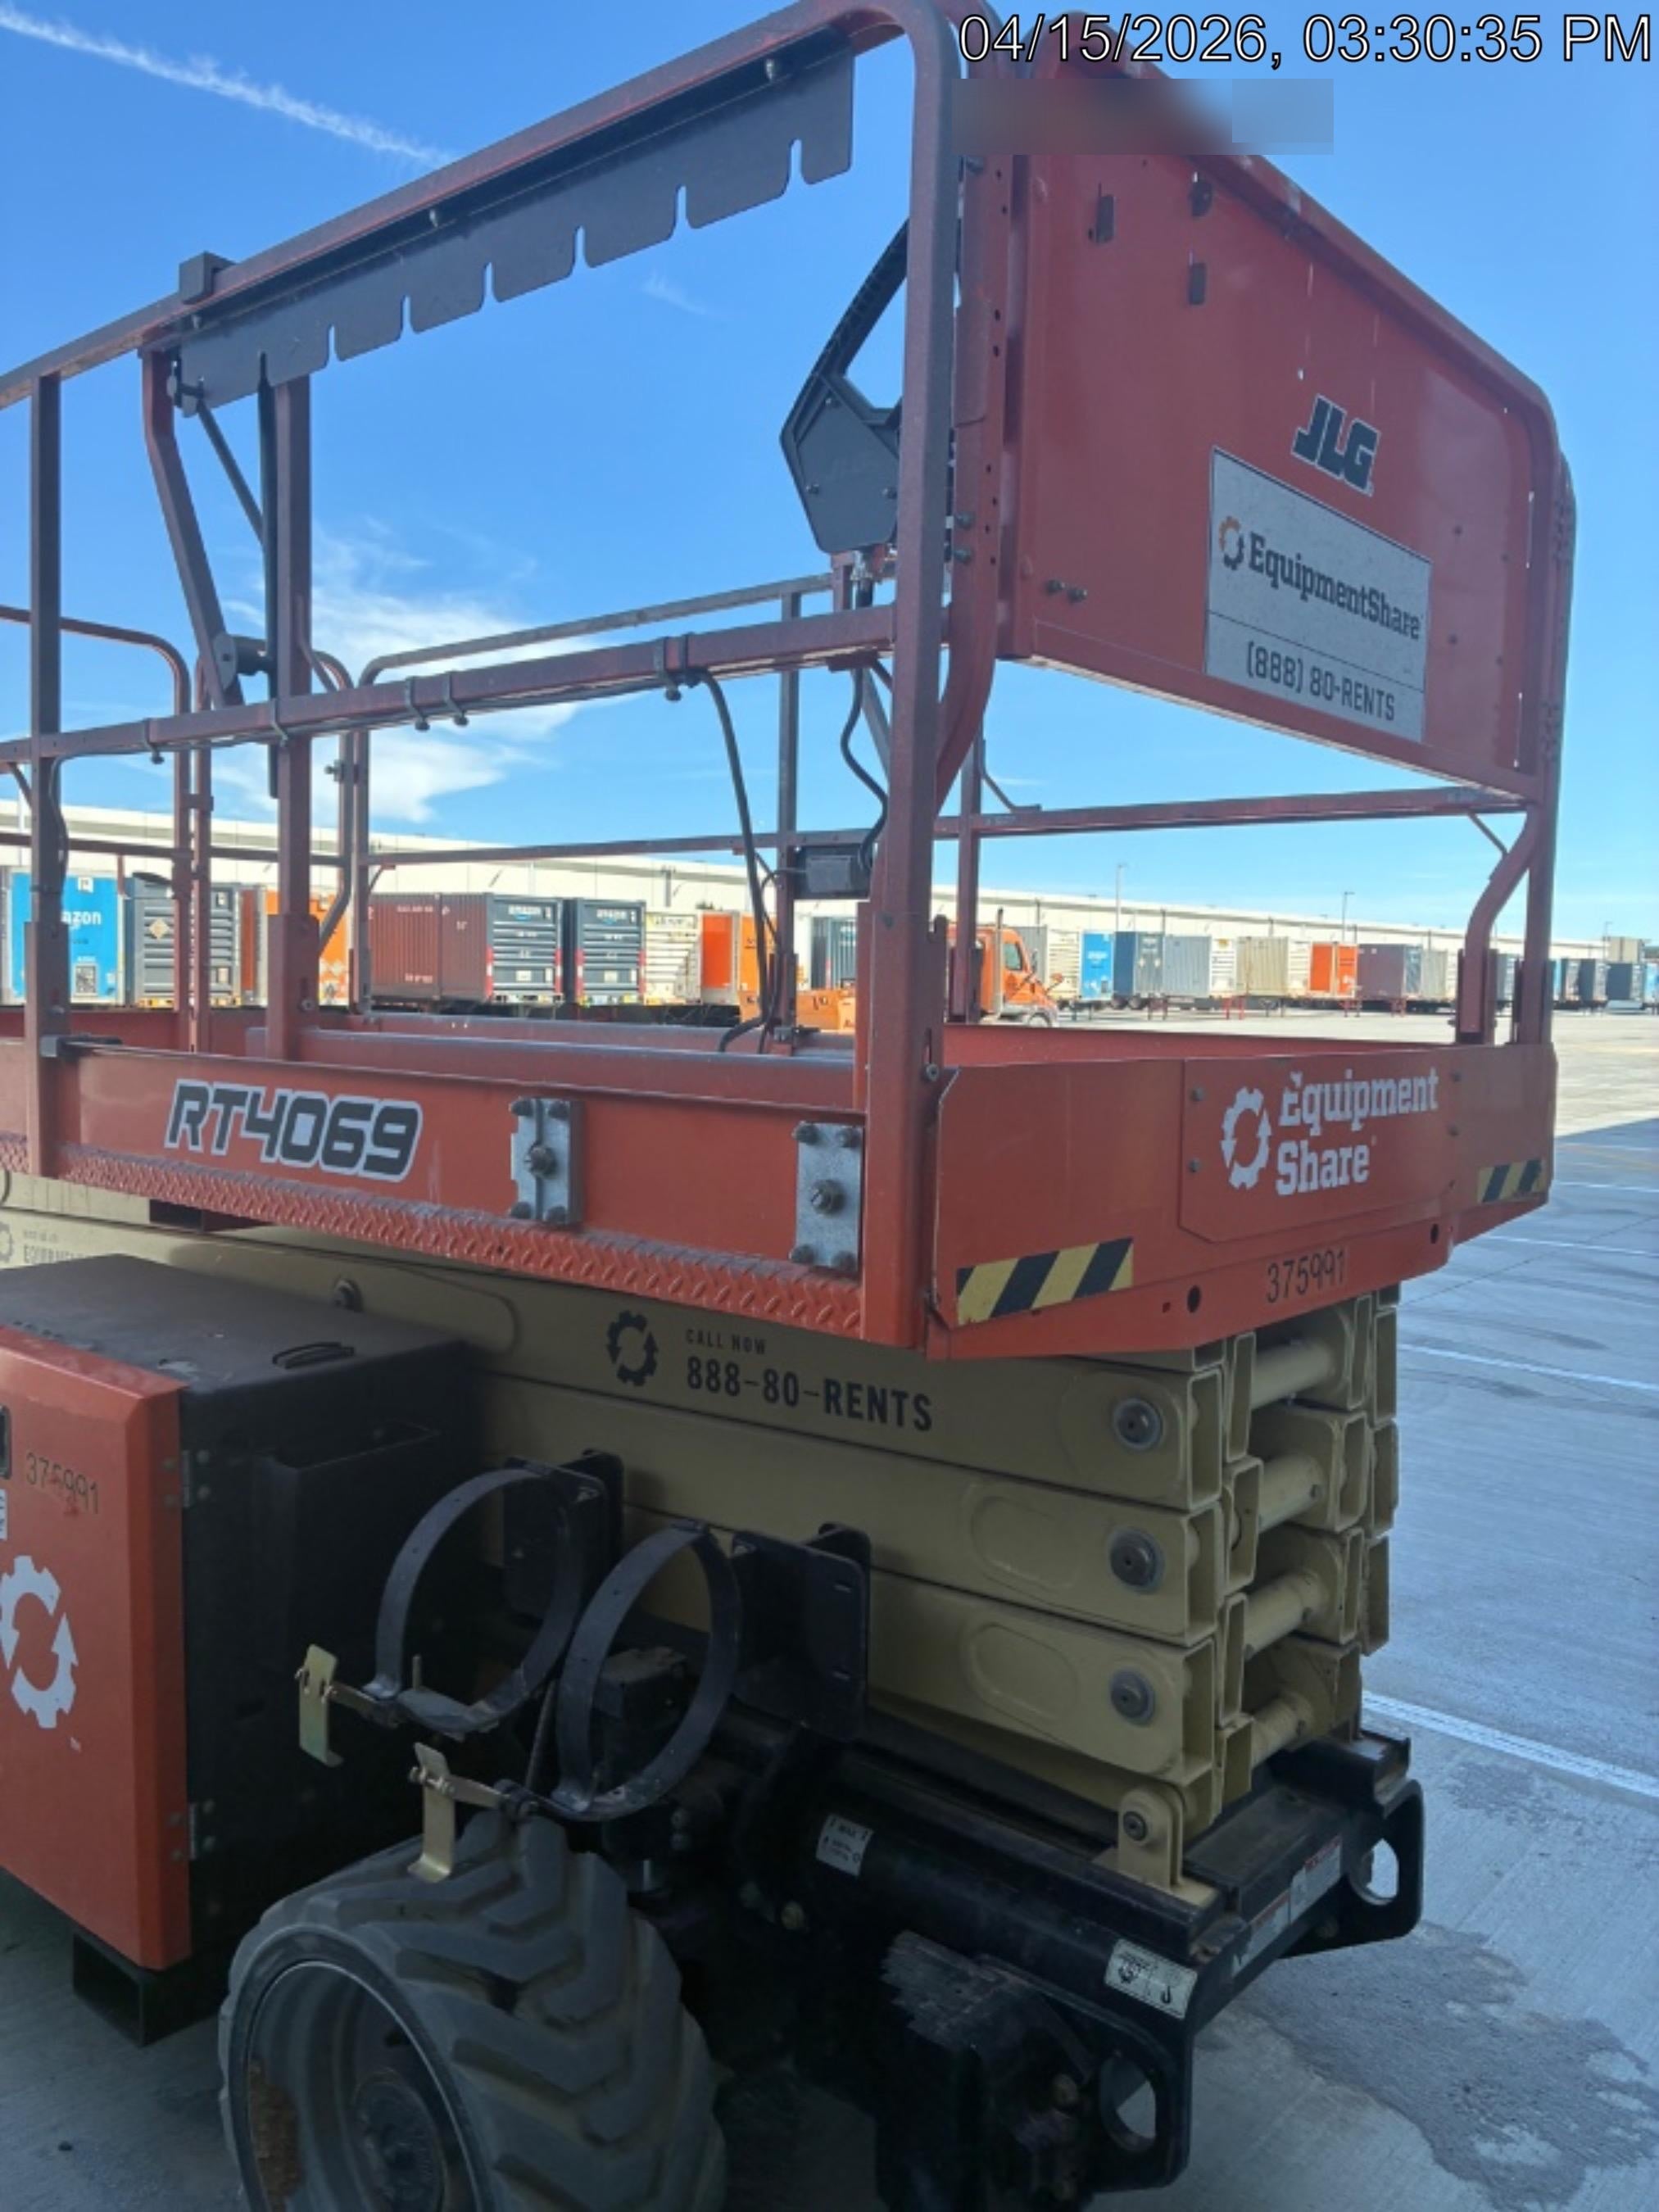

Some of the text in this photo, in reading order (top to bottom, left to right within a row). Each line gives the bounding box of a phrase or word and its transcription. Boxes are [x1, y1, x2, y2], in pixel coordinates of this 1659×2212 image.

[1291, 393, 1382, 496] JLG
[1249, 531, 1421, 641] EquipmentShare
[1247, 641, 1395, 722] (888) 80-RENTS
[61, 911, 102, 925] azon
[164, 1078, 423, 1183] RT4069
[1278, 1067, 1439, 1136] Equipment
[1276, 1140, 1370, 1196] Share
[1267, 1249, 1346, 1303] 375991
[686, 1329, 767, 1356] CALL NOW
[687, 1356, 932, 1432] 888-80-RENTS
